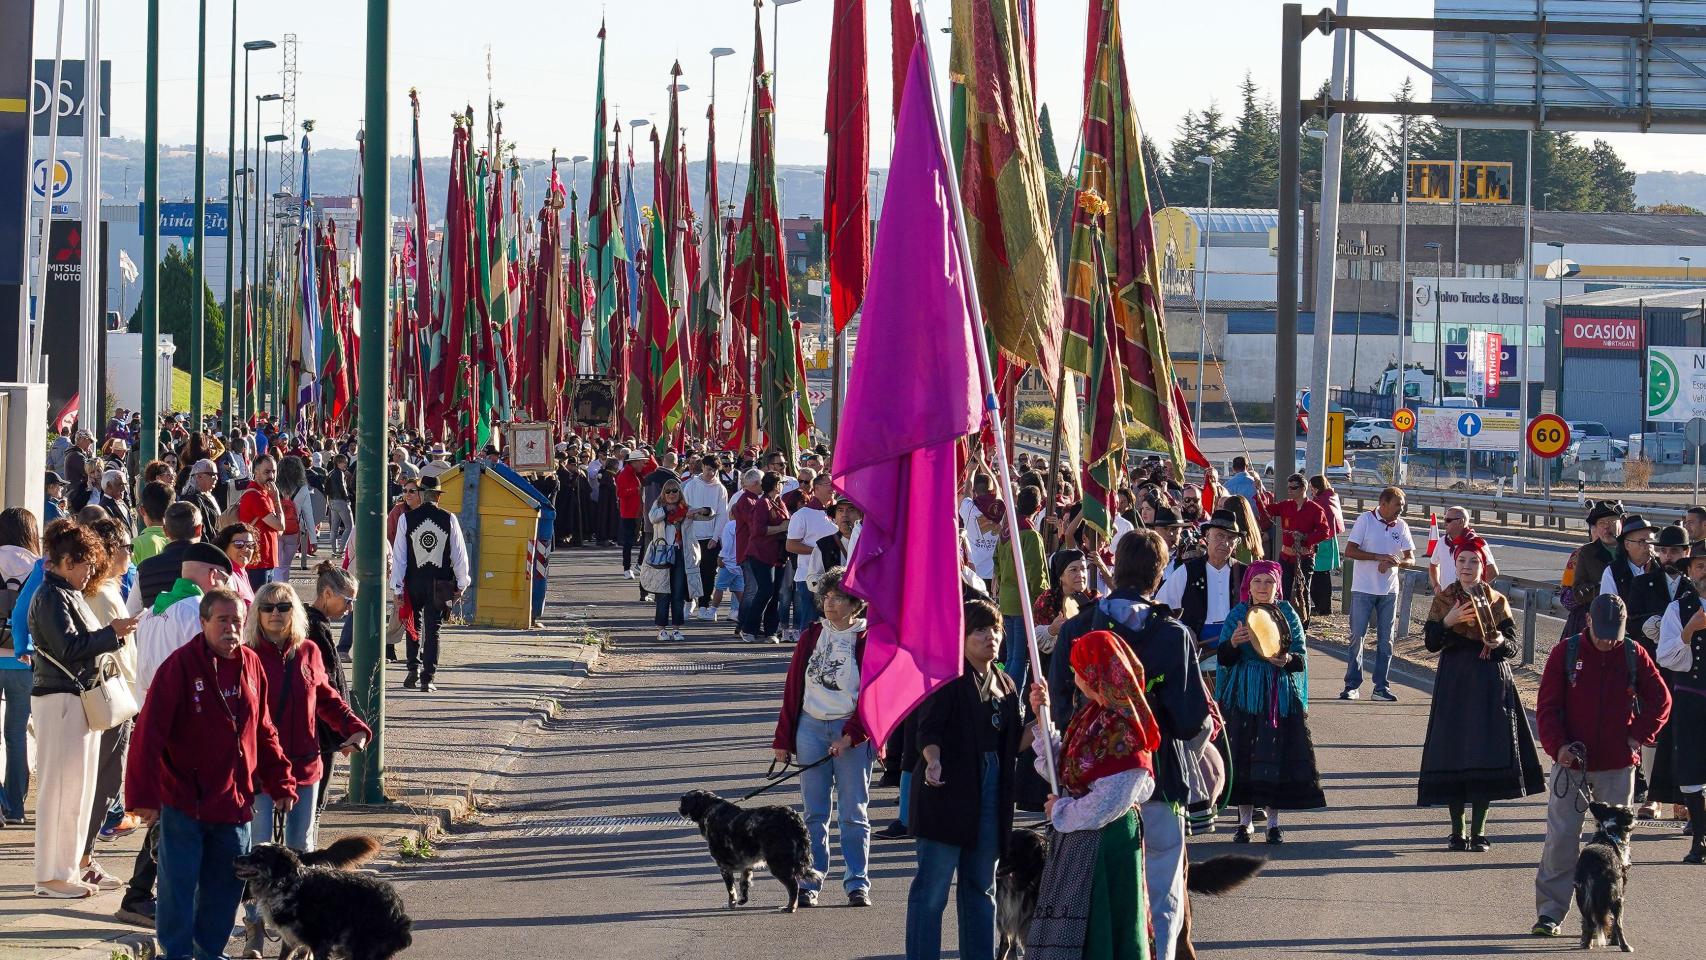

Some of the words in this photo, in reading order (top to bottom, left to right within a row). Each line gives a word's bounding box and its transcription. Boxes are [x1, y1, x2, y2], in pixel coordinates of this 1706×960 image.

[158, 212, 193, 227] hina
[48, 264, 81, 272] MITSUB
[54, 273, 81, 281] MOTO
[1434, 291, 1459, 303] Volvo
[1460, 291, 1490, 303] Trucks
[1492, 293, 1500, 304] &
[1573, 322, 1636, 340] OCASIÓN
[1603, 340, 1636, 348] NORTHGATE
[1488, 336, 1497, 394] NORTHGATE
[1397, 415, 1410, 426] 40
[1537, 428, 1561, 443] 60
